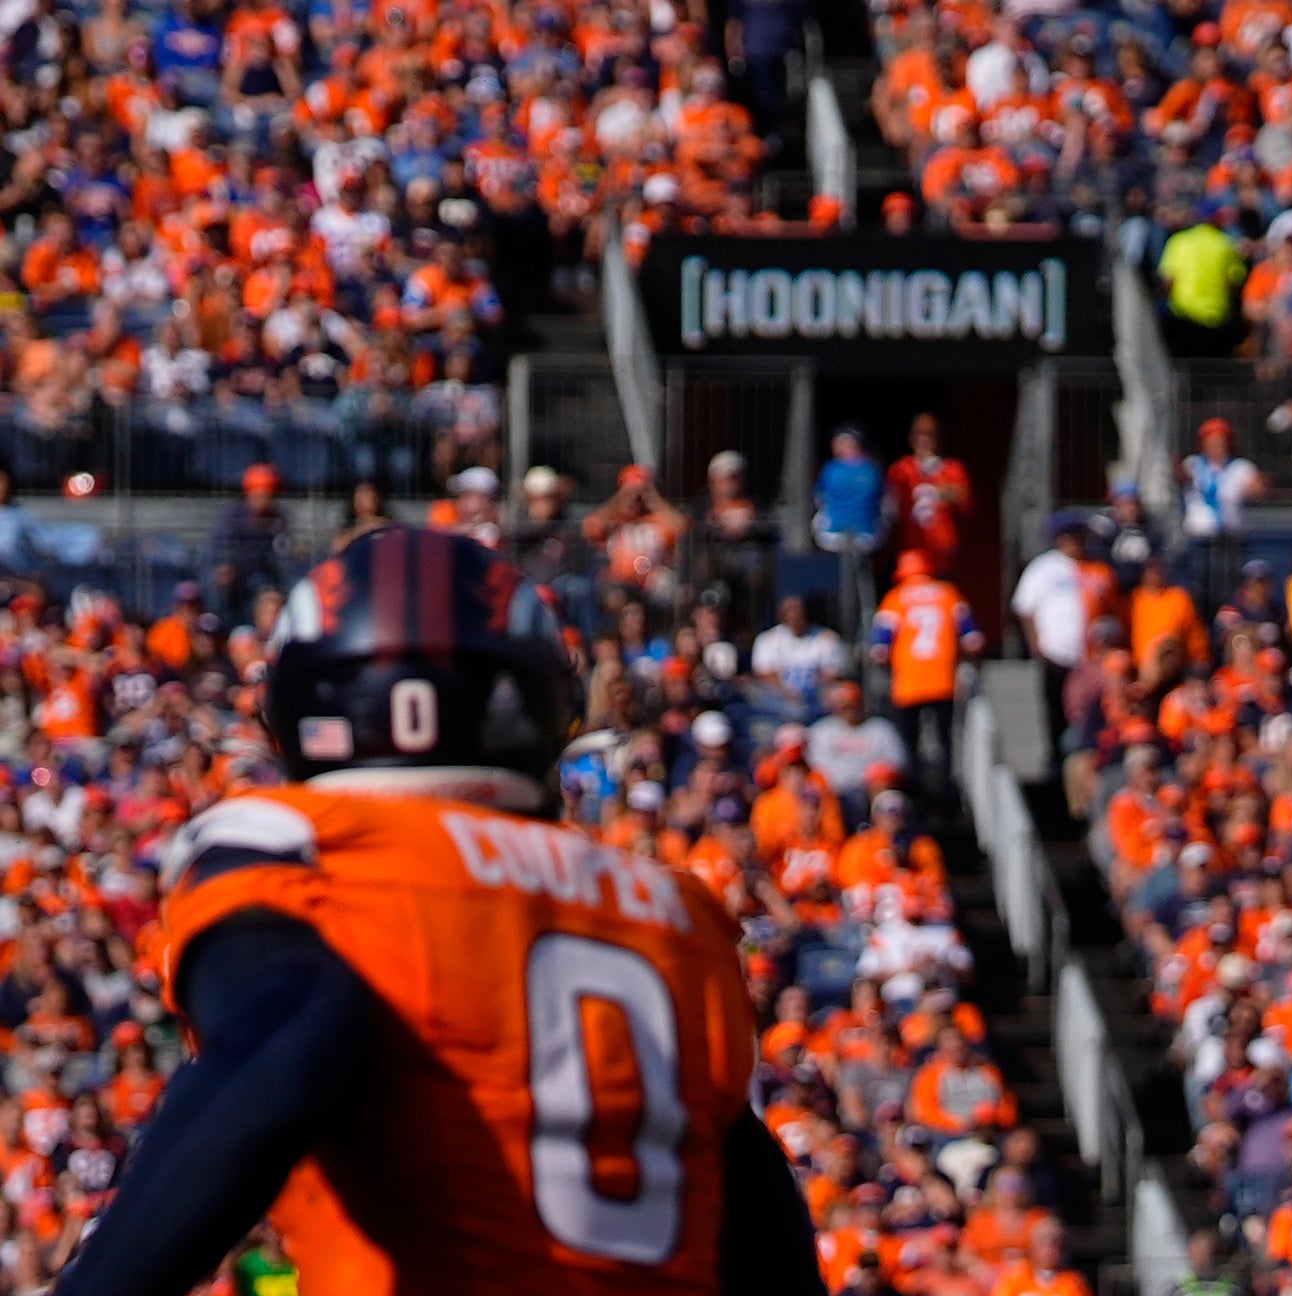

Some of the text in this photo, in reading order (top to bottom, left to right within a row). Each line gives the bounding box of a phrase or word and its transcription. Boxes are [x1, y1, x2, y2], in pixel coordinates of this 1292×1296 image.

[390, 679, 438, 753] 0
[440, 810, 693, 933] COOPER
[526, 931, 690, 1265] 0
